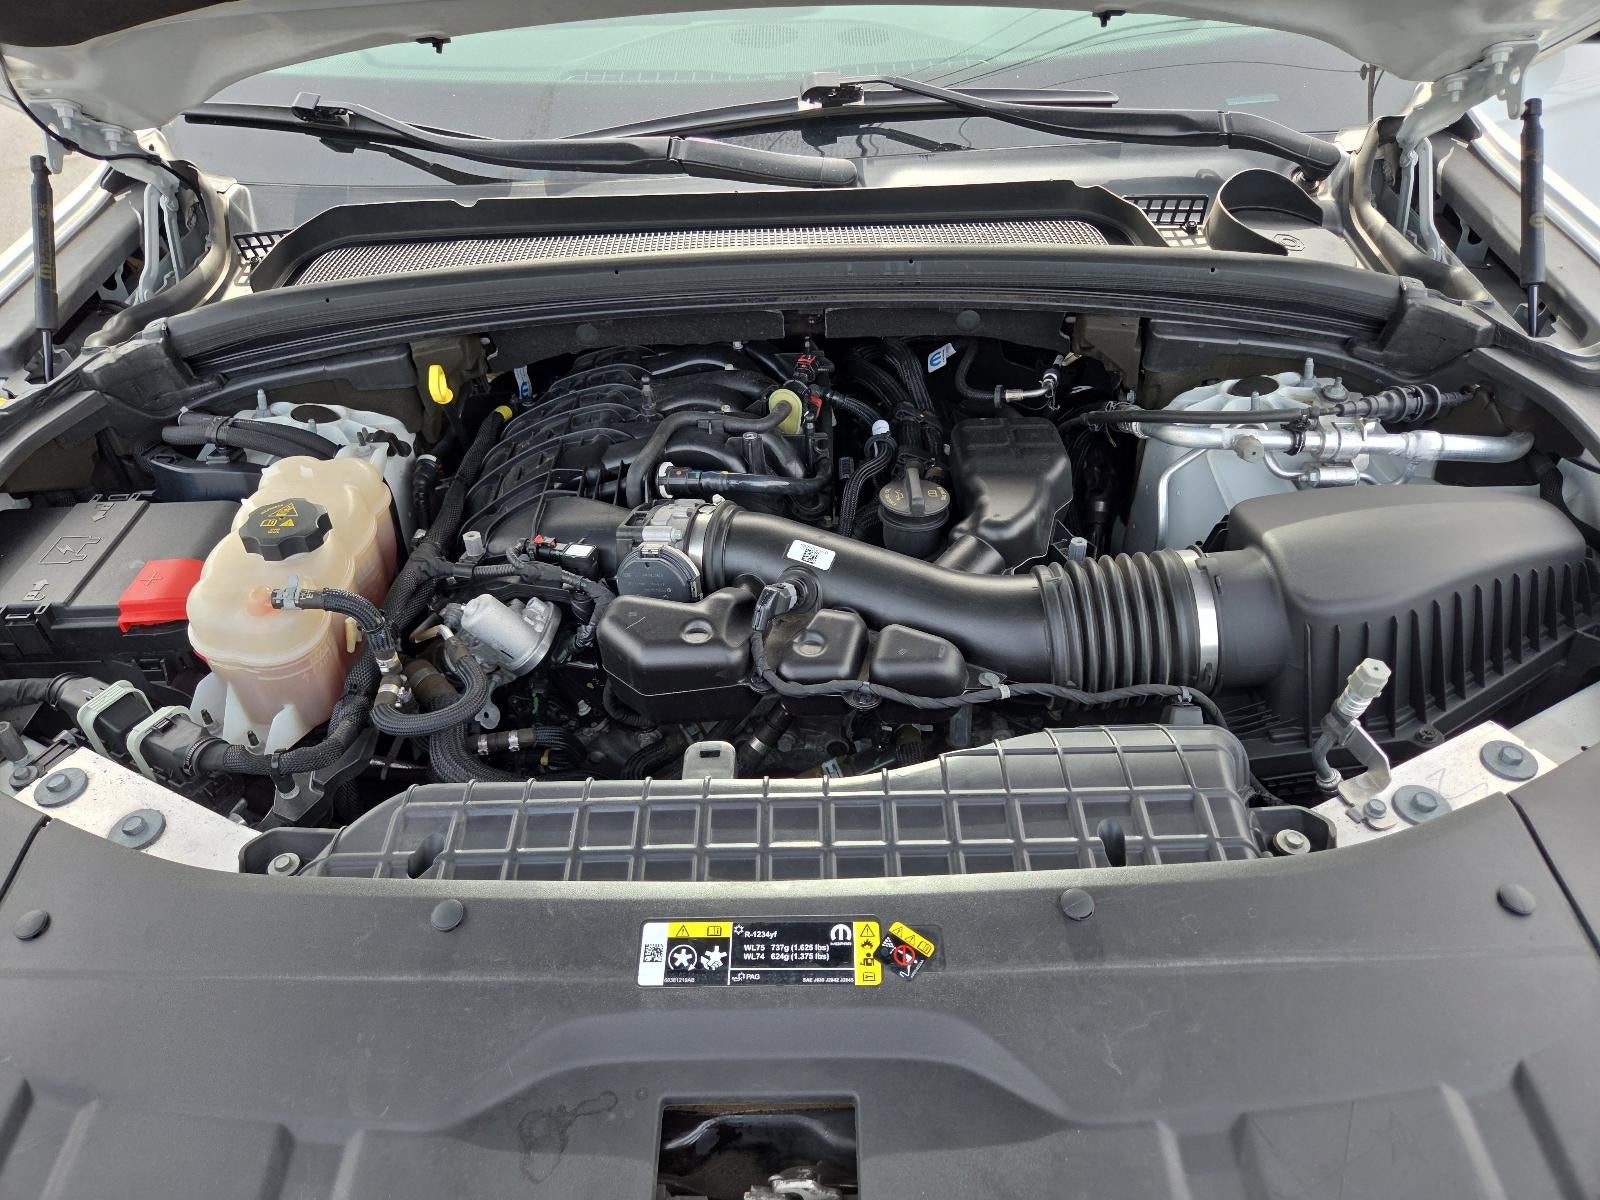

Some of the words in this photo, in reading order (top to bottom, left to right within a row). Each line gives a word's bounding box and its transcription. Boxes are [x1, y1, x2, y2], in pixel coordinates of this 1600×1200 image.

[744, 930, 778, 939] R-1234yf
[770, 944, 790, 952] 737g
[791, 944, 813, 952] (1.625
[815, 944, 830, 952] lbs)
[770, 953, 790, 961] 624g
[791, 953, 813, 961] (1.375
[815, 953, 830, 961] lbs)
